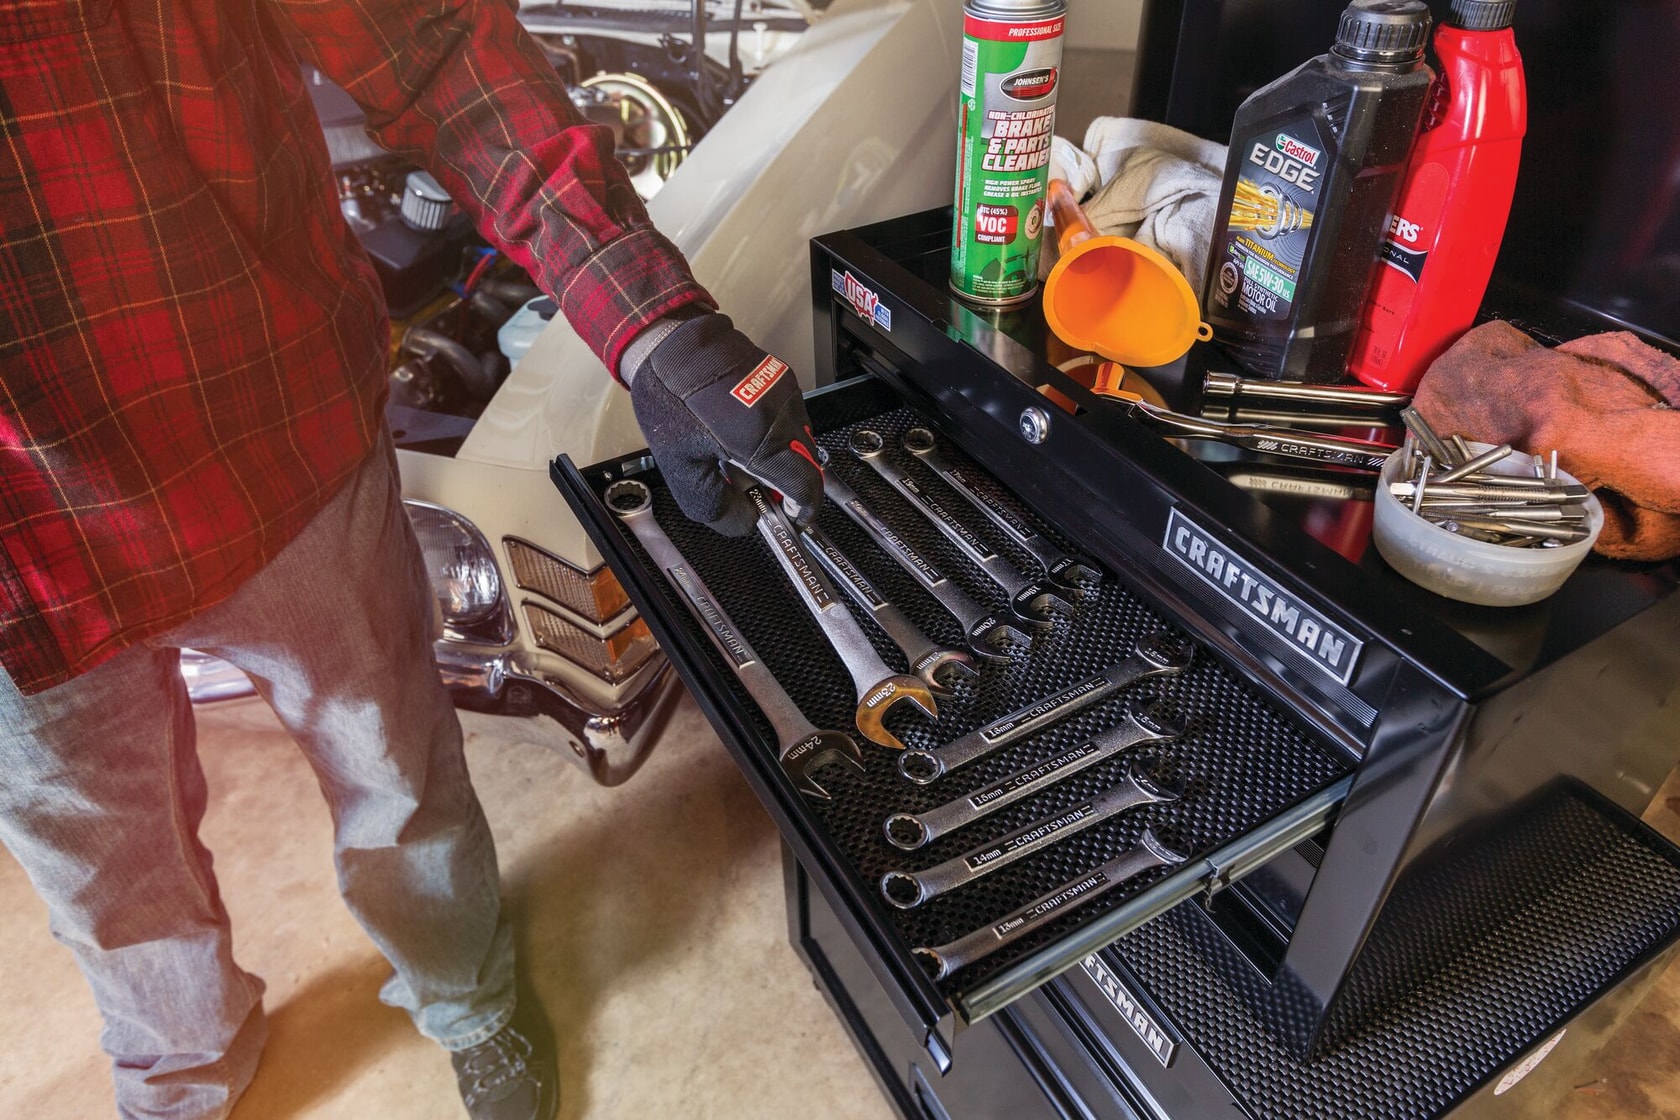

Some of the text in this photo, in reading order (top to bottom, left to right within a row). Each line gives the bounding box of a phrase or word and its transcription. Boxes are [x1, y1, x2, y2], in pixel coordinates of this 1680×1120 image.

[1008, 25, 1052, 36] PROFESSIONAL
[1013, 75, 1049, 86] JOHNSEN'S
[994, 115, 1052, 138] BRAKE
[988, 135, 1050, 154] & PARTS
[1285, 140, 1316, 165] Castrol
[1249, 142, 1320, 192] EDGE
[977, 233, 1005, 243] COMPLIANT
[979, 215, 1007, 233] VOC
[1245, 237, 1275, 261] TITANIUM
[1247, 260, 1259, 280] SAE
[1259, 267, 1284, 294] 5W-30
[848, 278, 873, 316] USA
[1242, 282, 1266, 307] MOTOR
[1265, 297, 1276, 313] OIL
[1281, 443, 1364, 464] CRAFTSMAN
[930, 503, 979, 546] CRAFTSMAN
[977, 491, 1024, 530] CRAFTSMAN
[749, 488, 824, 595] 23mm CRAFTSMAN
[880, 527, 930, 571] CRAFTSMAN
[825, 546, 874, 596] CRAFTSMAN
[1175, 526, 1346, 668] CRAFTSMAN
[697, 596, 744, 655] CRAFTSMAN
[971, 617, 996, 637] 20mm
[866, 682, 896, 708] 23mm
[1030, 682, 1095, 718] CRAFTSMAN
[788, 735, 822, 761] 24mm
[974, 748, 1086, 805] 15mm CRAFTSMAN
[973, 809, 1084, 866] 14mm CRAFTSMAN
[998, 877, 1098, 934] 13mm CRAFTSMAN
